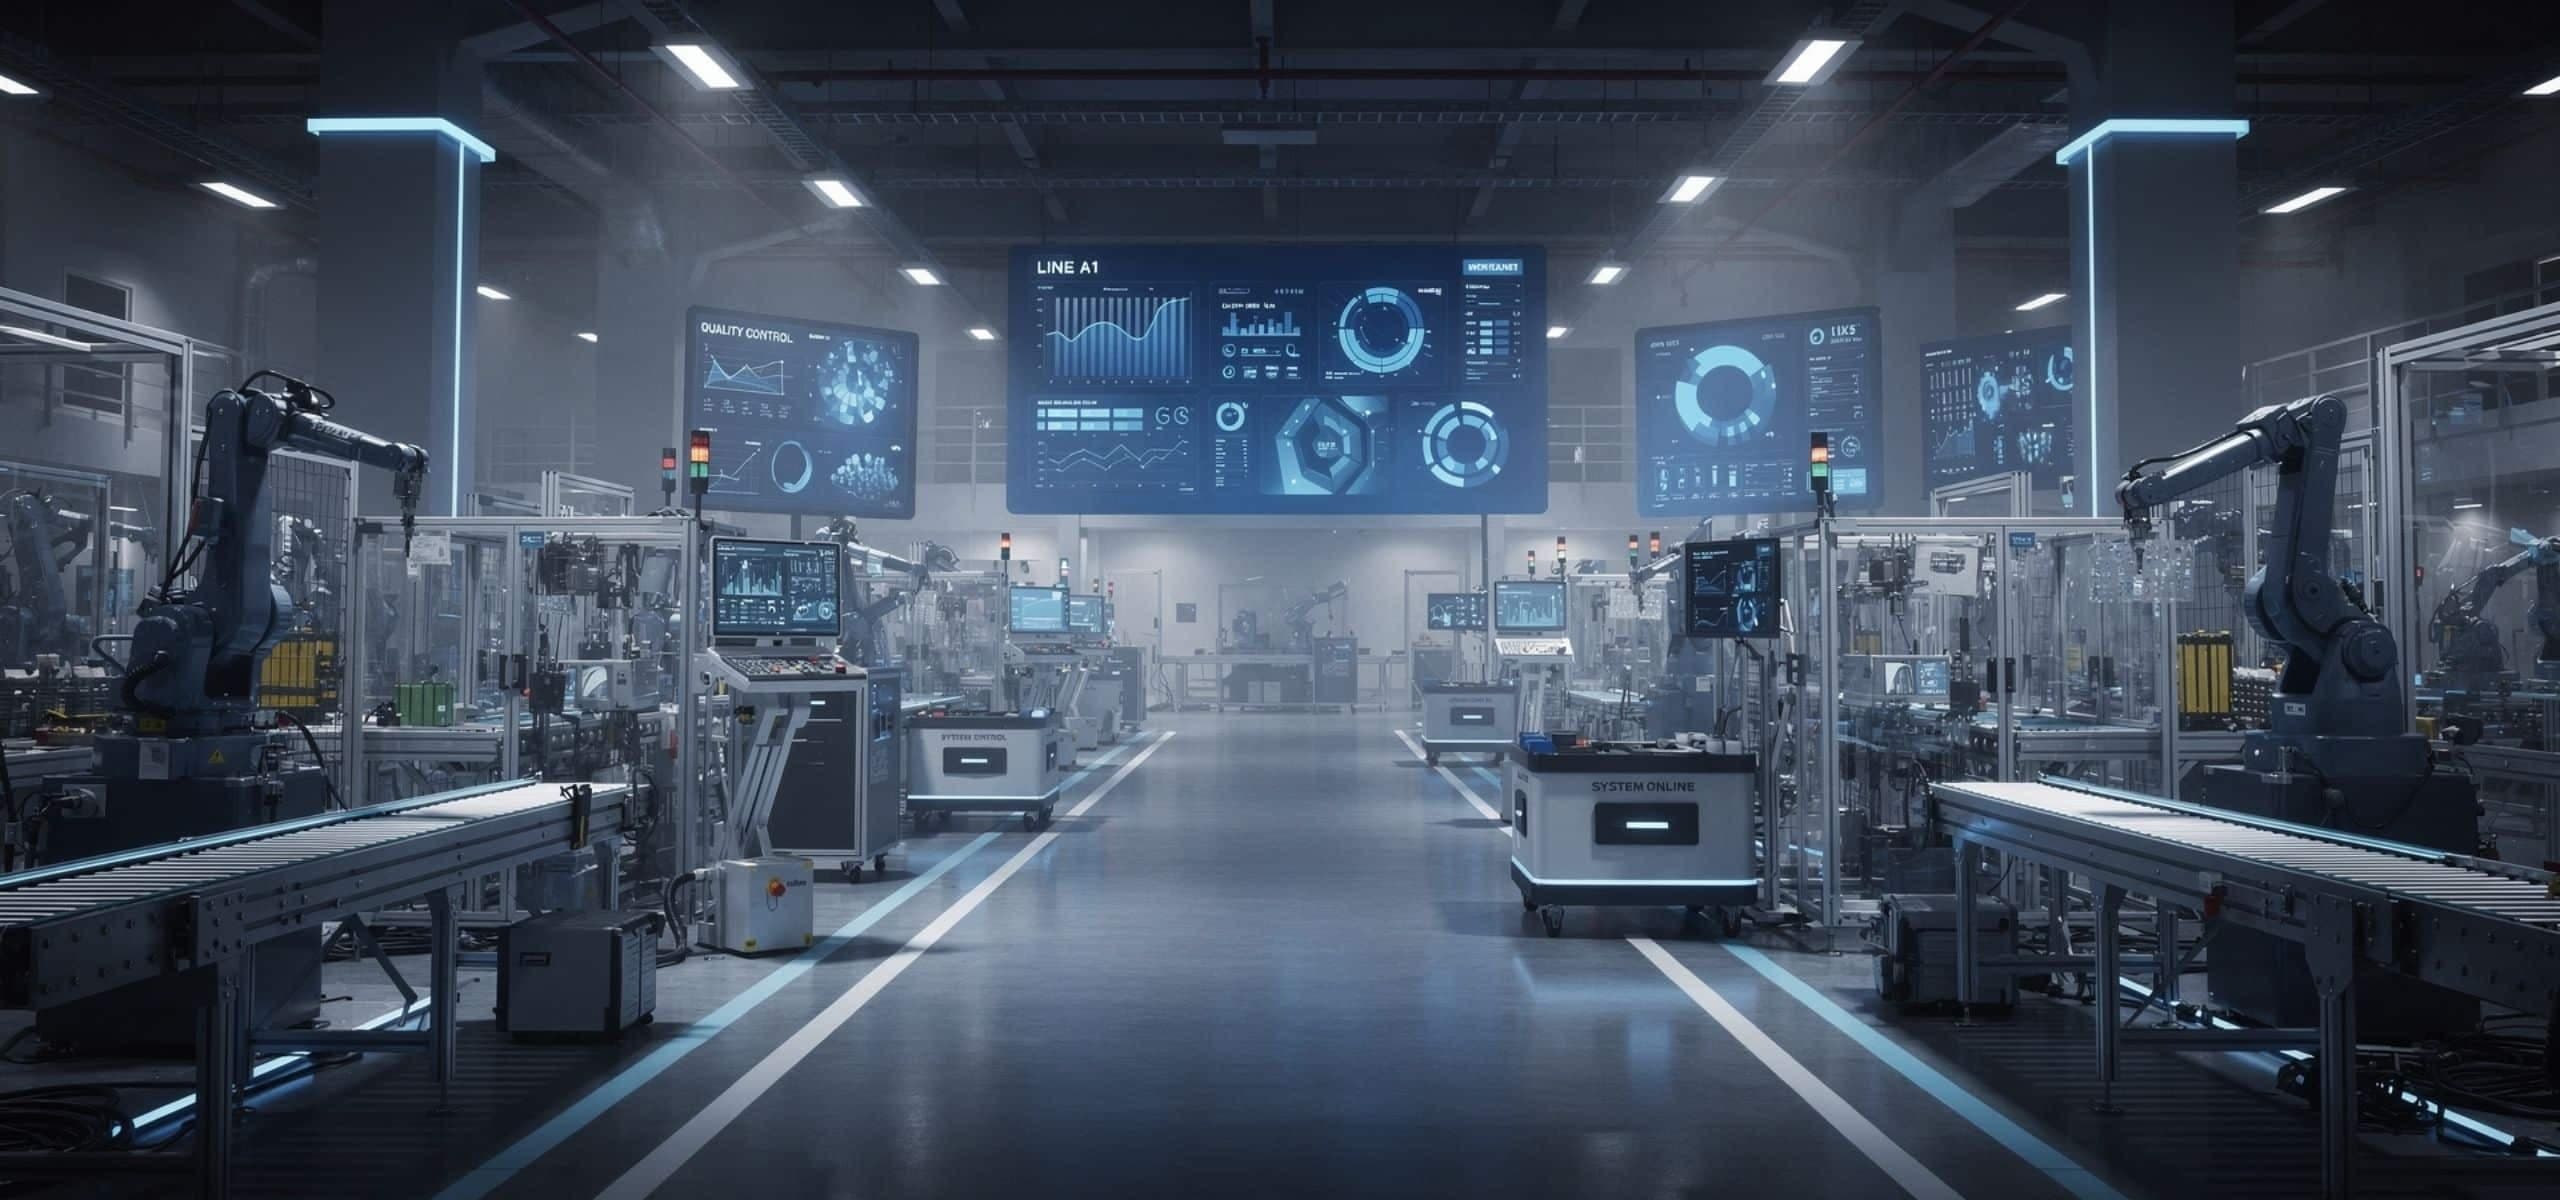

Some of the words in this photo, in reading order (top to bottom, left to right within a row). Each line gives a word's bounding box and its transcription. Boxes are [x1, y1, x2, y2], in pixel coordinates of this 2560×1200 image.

[1037, 260, 1074, 274] LINE
[1079, 260, 1098, 274] A1
[700, 322, 744, 337] QUALITY
[745, 327, 793, 344] CONTROL
[1591, 781, 1644, 792] SYSTEM
[1646, 781, 1695, 792] ONLINE
